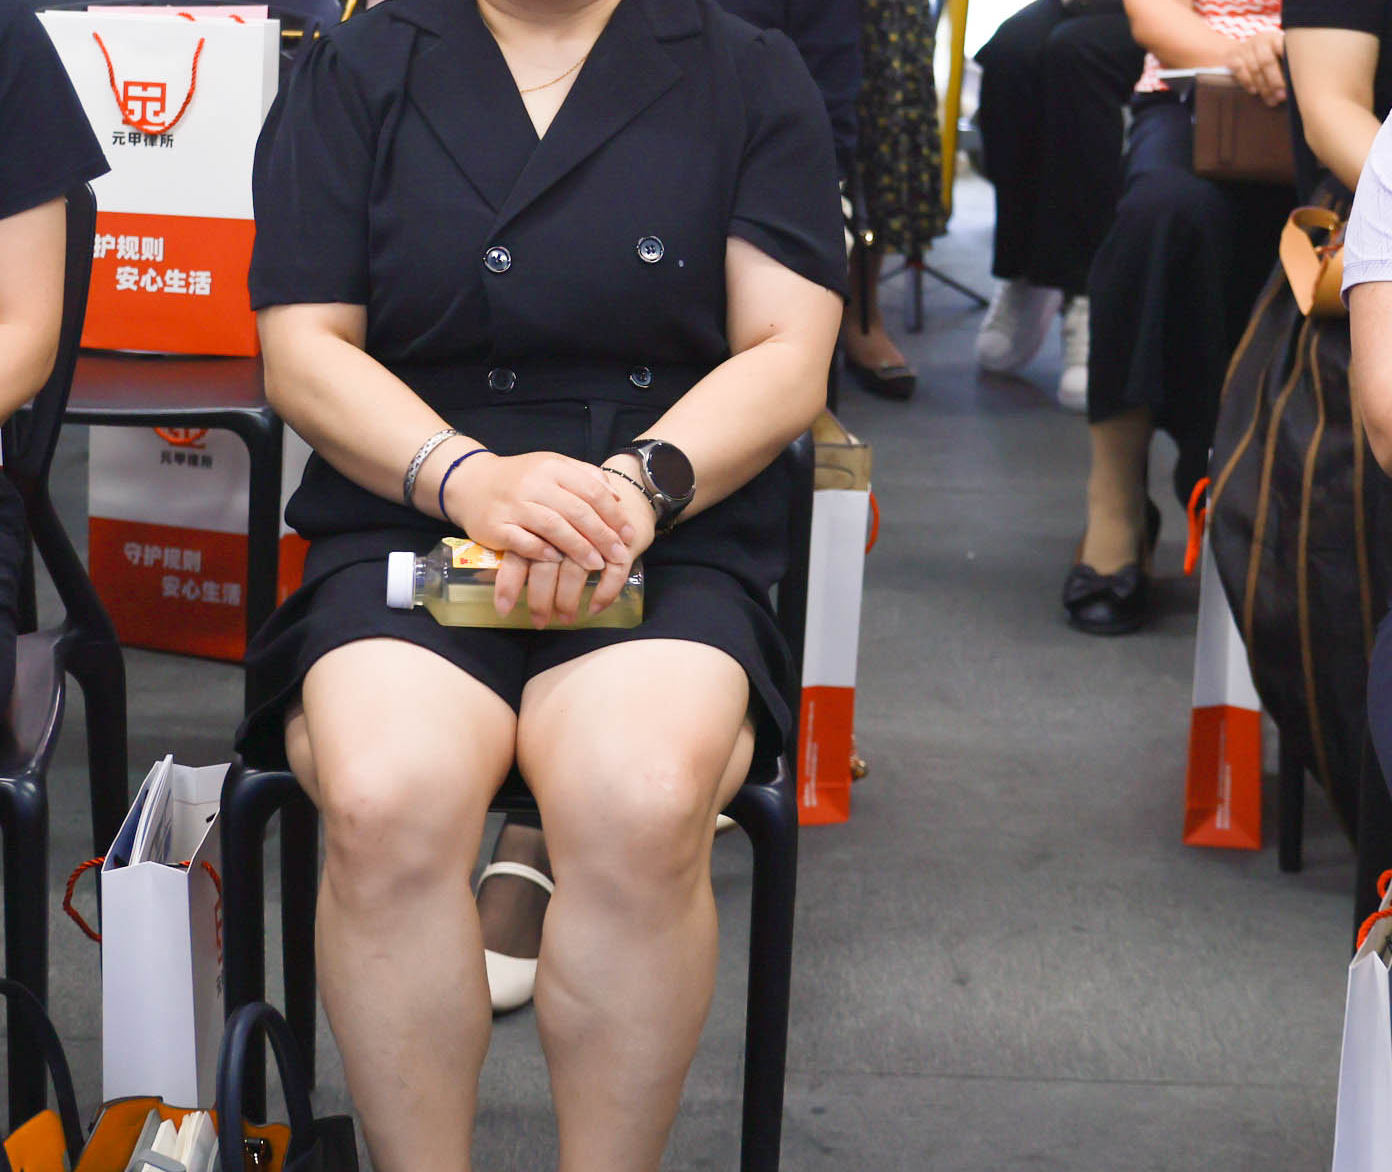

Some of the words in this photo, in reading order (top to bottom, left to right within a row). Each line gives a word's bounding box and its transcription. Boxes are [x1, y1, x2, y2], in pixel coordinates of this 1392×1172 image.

[112, 131, 174, 148] 元甲律所
[115, 266, 212, 295] 安心生活
